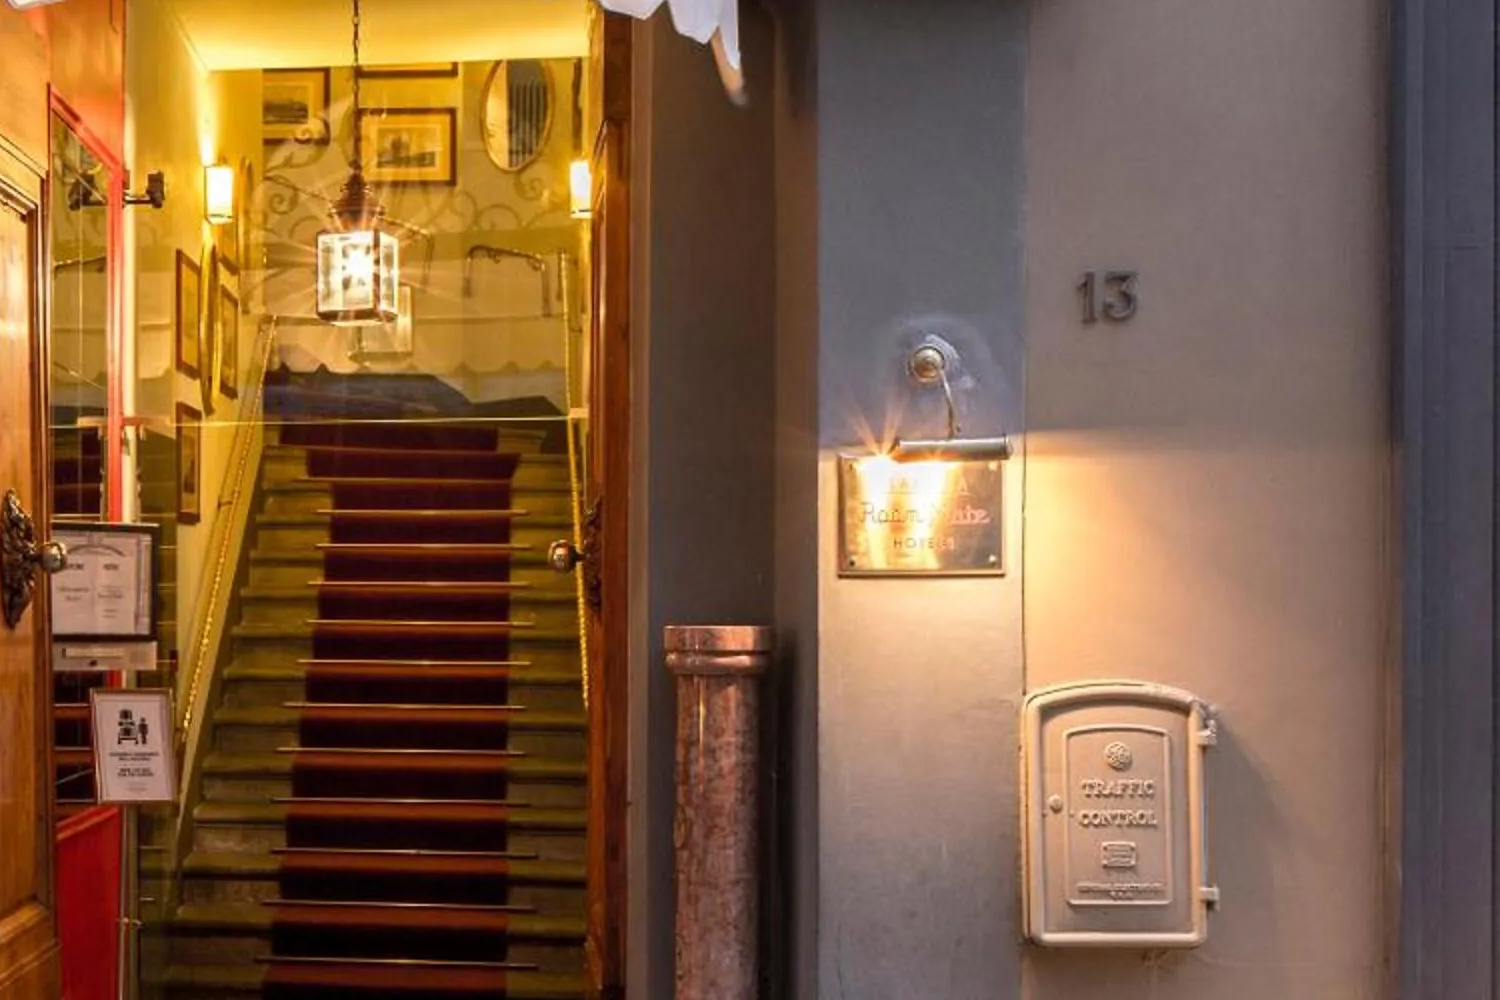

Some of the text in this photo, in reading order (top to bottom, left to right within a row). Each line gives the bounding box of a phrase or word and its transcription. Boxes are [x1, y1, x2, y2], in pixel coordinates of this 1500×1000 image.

[1076, 270, 1138, 325] 13
[1081, 778, 1155, 799] TRAFFIC
[1079, 808, 1157, 828] CONTROL
